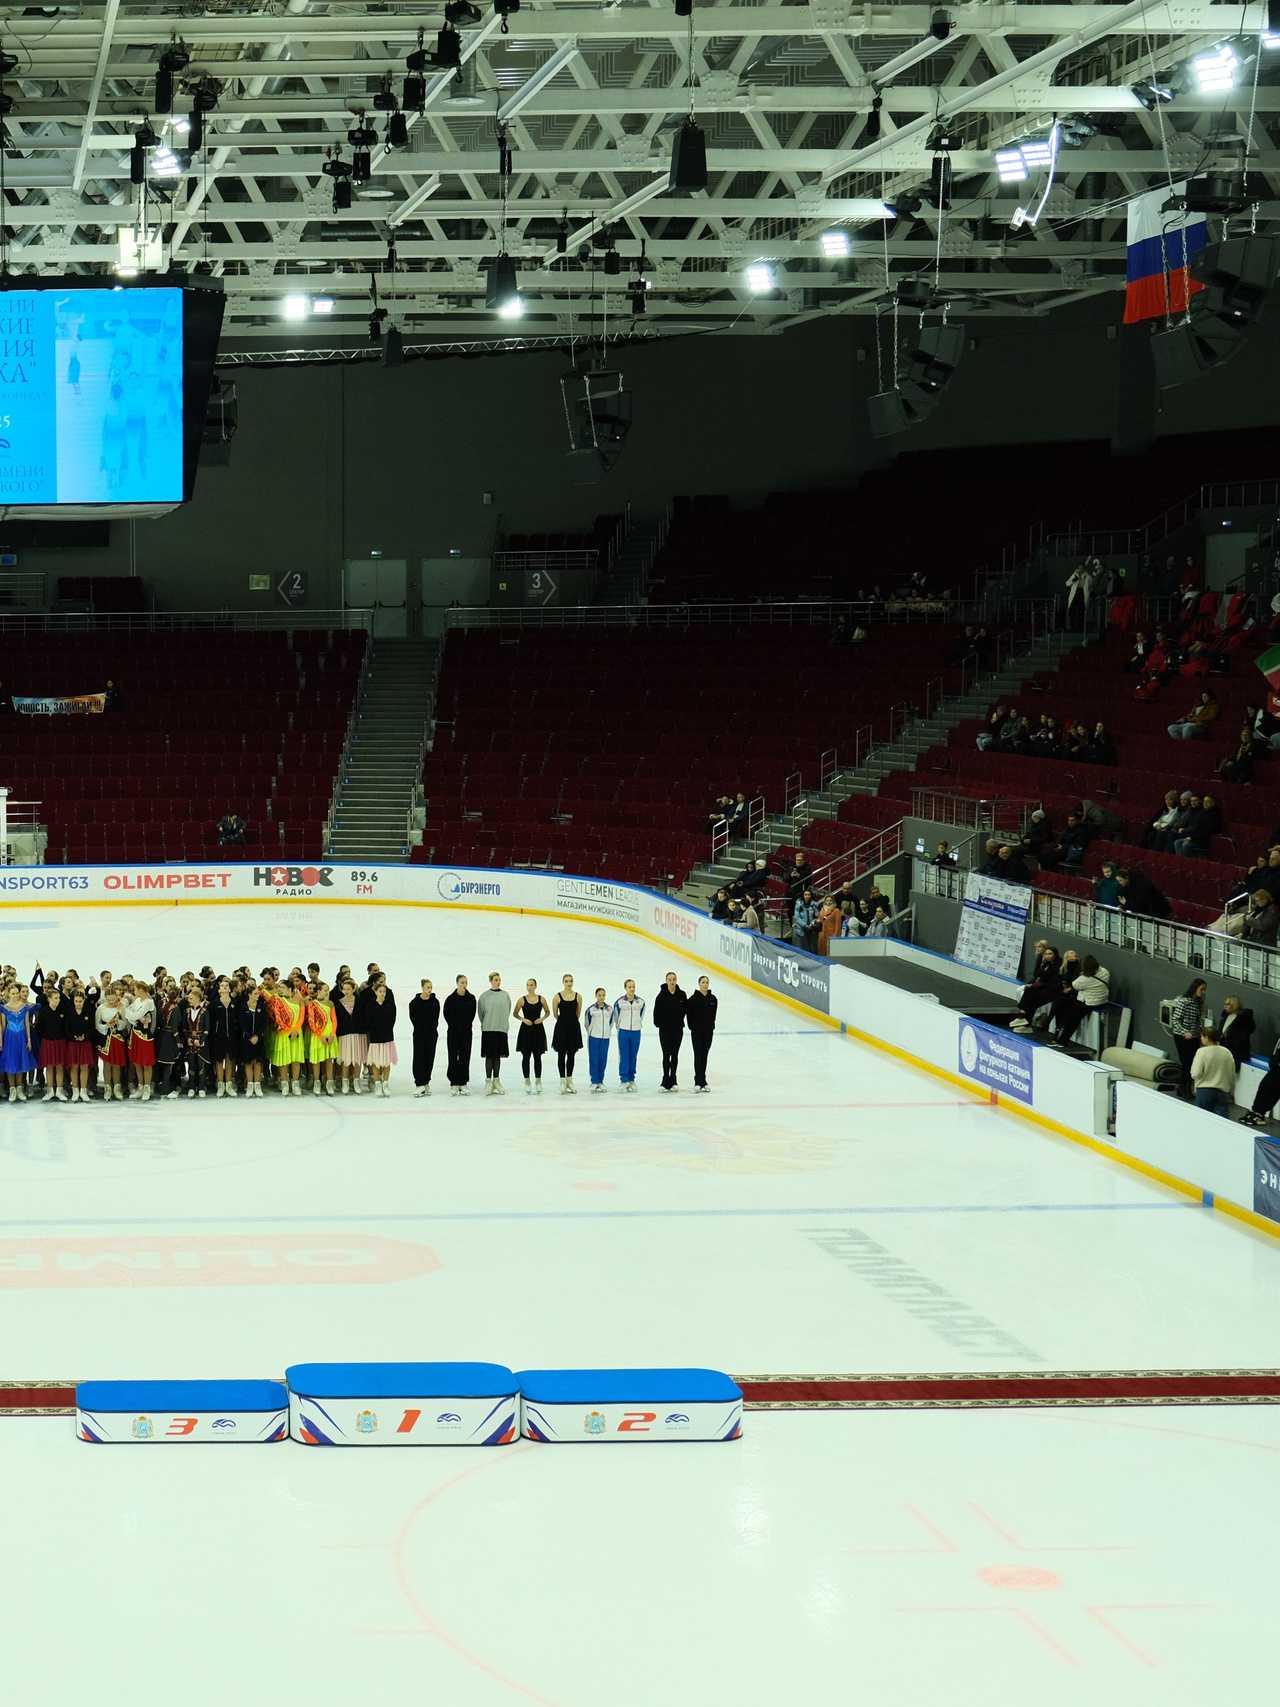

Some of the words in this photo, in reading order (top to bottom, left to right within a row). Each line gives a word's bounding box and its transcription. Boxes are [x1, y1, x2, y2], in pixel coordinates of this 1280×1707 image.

[2, 390, 49, 400] КОНЬКАХ
[292, 573, 301, 589] 2
[531, 573, 541, 589] 3
[103, 873, 232, 890] OLIMPBET
[350, 870, 378, 883] 89.6
[276, 888, 312, 896] РАДИО
[356, 884, 373, 894] FM
[460, 881, 501, 896] БУРЭНЕРГО
[556, 879, 614, 899] GENTLEMEN
[615, 888, 639, 906] LEAGUE
[556, 900, 587, 911] МАГАЗИН
[587, 904, 616, 915] МУЖСКИХ
[615, 909, 640, 923] КОСТЮМОВ
[654, 906, 699, 942] OLIMPBET
[753, 953, 776, 971] ЭНЕРГИЯ
[777, 955, 799, 988] ГЭС
[801, 973, 828, 993] СТРОИТЬ
[988, 1039, 1020, 1062] Федерация
[978, 1048, 1008, 1070] фигурного
[1007, 1062, 1031, 1081] катания
[978, 1064, 987, 1075] на
[986, 1067, 1009, 1085] коньках
[1008, 1073, 1029, 1095] России
[1260, 1168, 1280, 1192] ЭН
[795, 1227, 1051, 1364] ПОЛИПЛАСТ
[163, 1417, 200, 1436] 3
[395, 1407, 422, 1434] 1
[616, 1411, 658, 1432] 2
